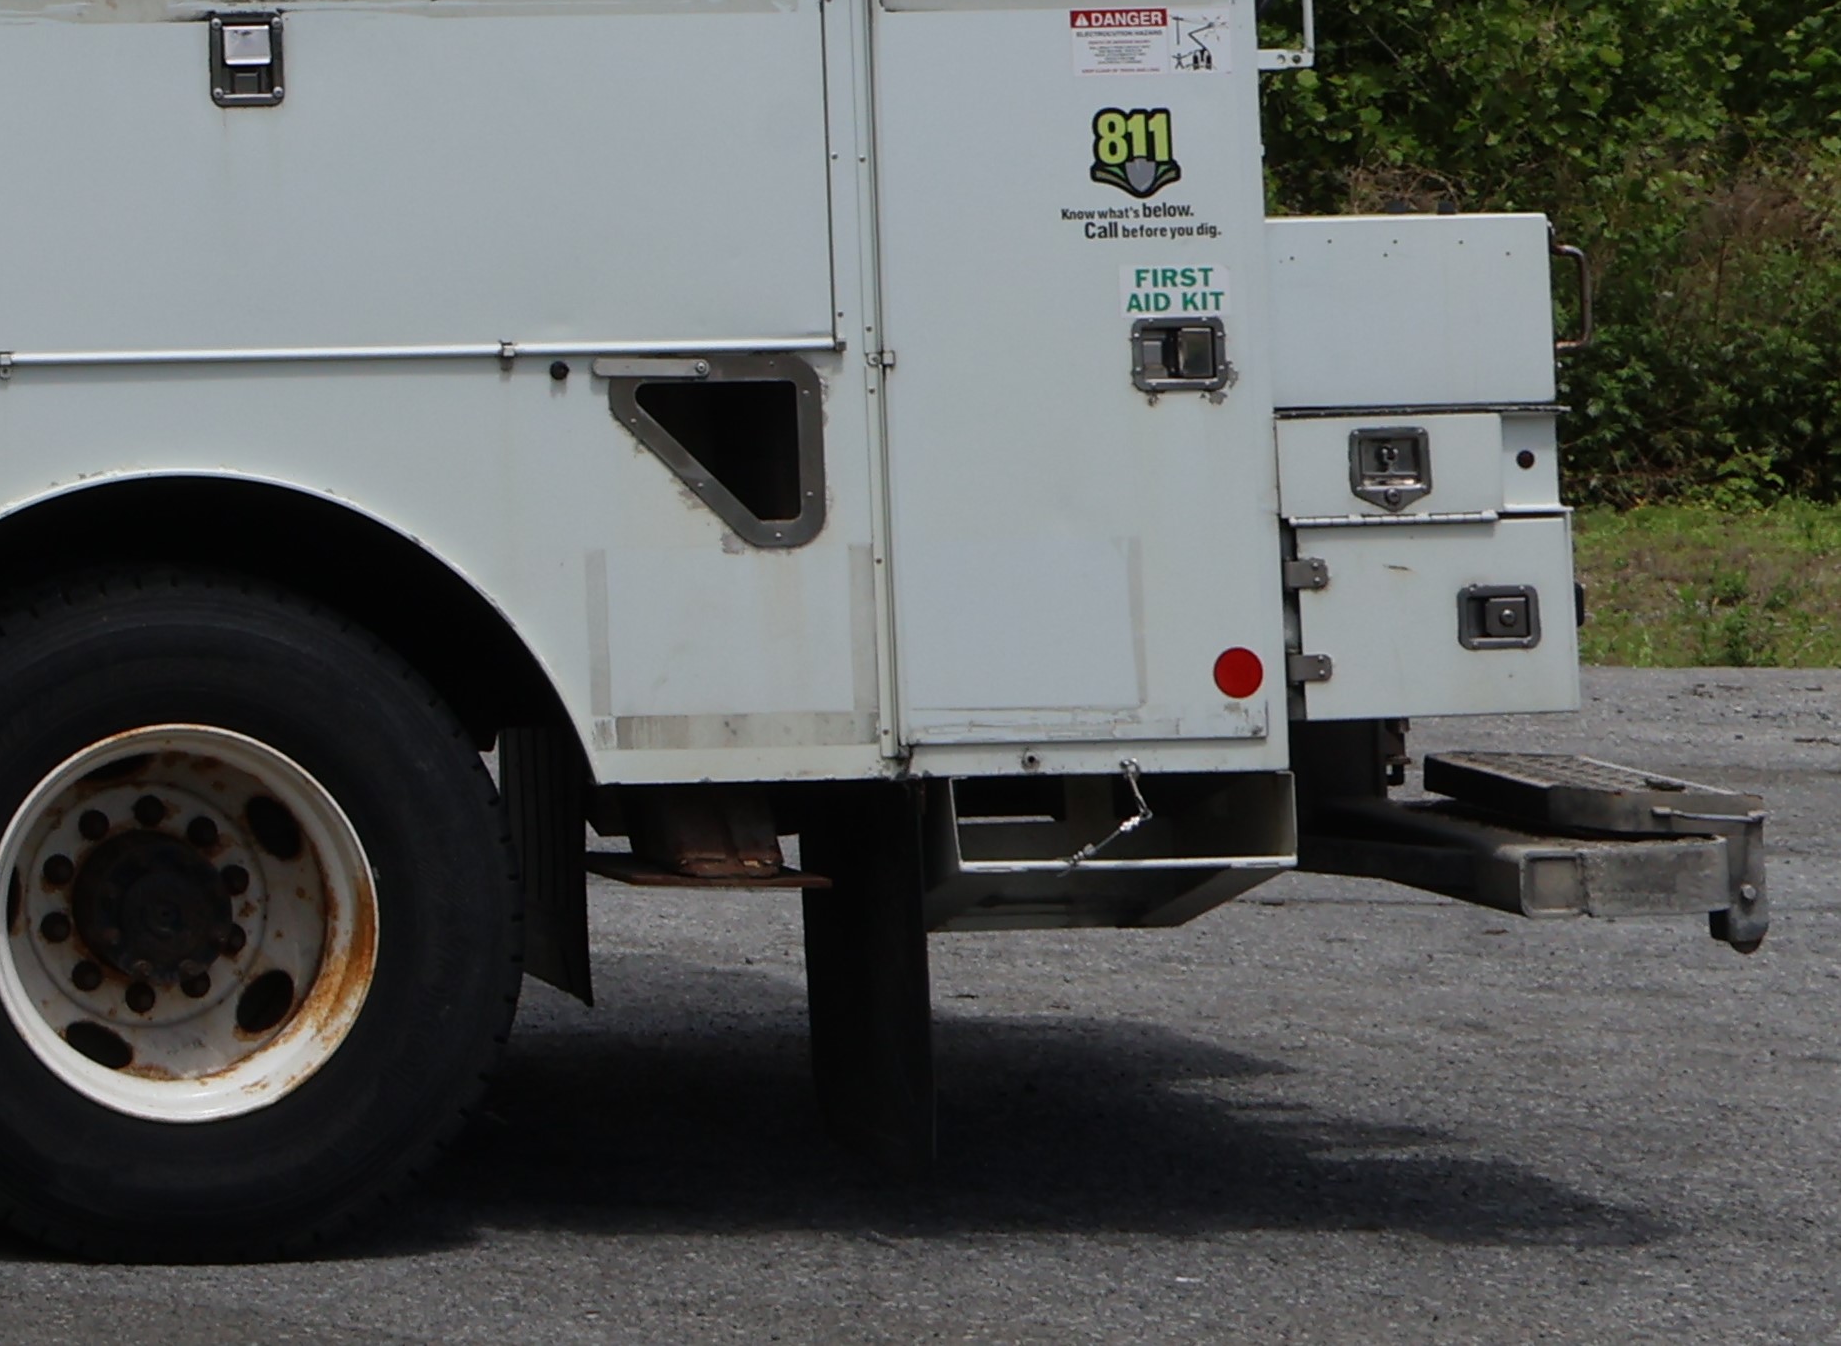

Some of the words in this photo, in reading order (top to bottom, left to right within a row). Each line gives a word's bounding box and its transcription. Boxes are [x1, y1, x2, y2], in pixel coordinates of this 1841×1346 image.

[1090, 10, 1164, 27] DANGER
[1096, 110, 1171, 166] 811
[1060, 208, 1096, 220] Know
[1097, 206, 1140, 220] what's
[1142, 202, 1195, 219] below.
[1084, 221, 1119, 240] Call
[1122, 224, 1168, 239] before
[1170, 226, 1194, 240] you
[1196, 222, 1223, 239] dig.
[1134, 266, 1214, 289] FIRST
[1126, 292, 1172, 313] AID
[1181, 291, 1225, 312] KIT
